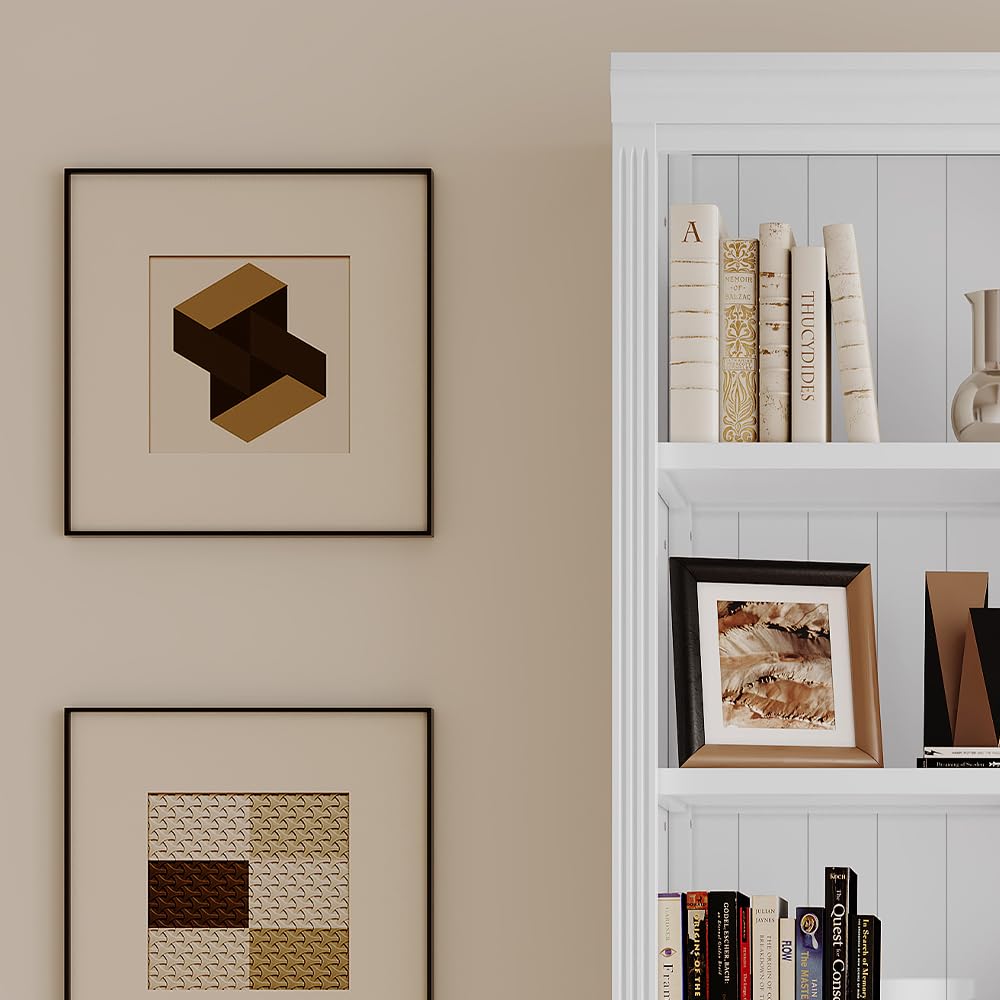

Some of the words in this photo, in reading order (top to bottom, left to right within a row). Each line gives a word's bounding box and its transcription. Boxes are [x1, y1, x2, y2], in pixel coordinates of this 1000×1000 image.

[681, 221, 702, 243] A
[800, 291, 816, 402] THUCYDIDES
[830, 903, 846, 946] Quest
[862, 919, 869, 928] In
[694, 914, 702, 957] ORIGINS
[782, 940, 792, 962] FLOW
[801, 951, 810, 967] The
[694, 960, 702, 973] OF
[862, 958, 869, 966] of
[694, 976, 702, 996] THE
[767, 980, 772, 990] OF
[860, 968, 869, 1000] Memory
